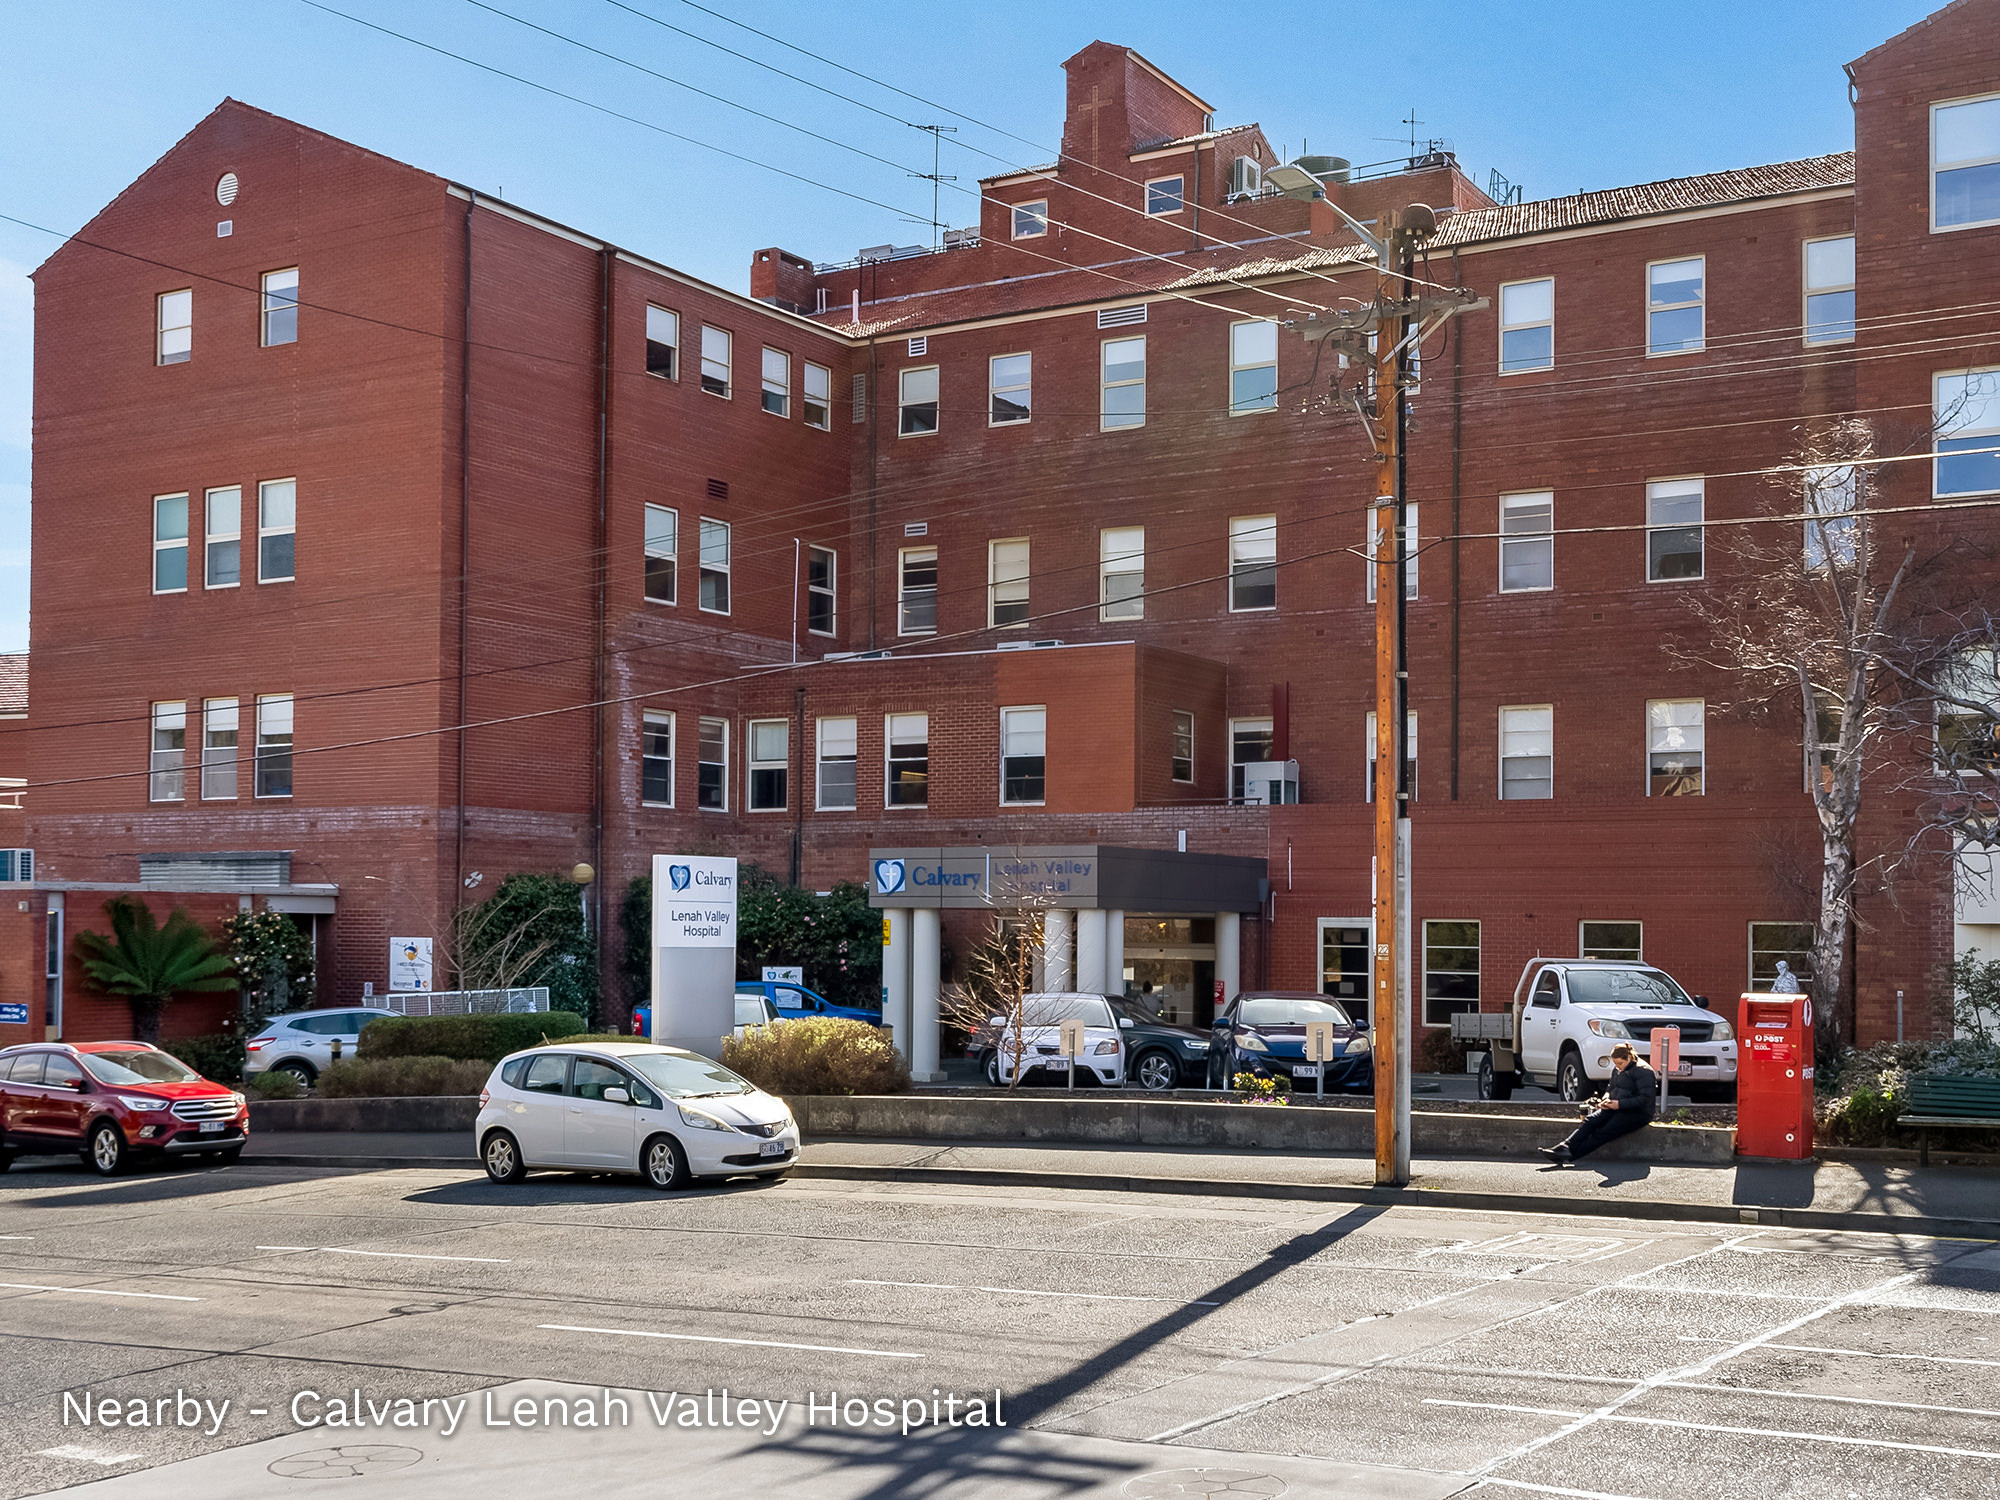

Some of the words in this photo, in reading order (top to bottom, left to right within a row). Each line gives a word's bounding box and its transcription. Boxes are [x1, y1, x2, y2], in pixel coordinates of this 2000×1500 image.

[994, 861, 1039, 876] Lenah
[1044, 861, 1092, 876] Valley
[695, 870, 733, 889] Calvary
[912, 866, 982, 890] Calvary
[671, 910, 702, 922] Lenah
[704, 910, 730, 924] Valley
[683, 925, 722, 939] Hospital
[1763, 1035, 1784, 1043] POST
